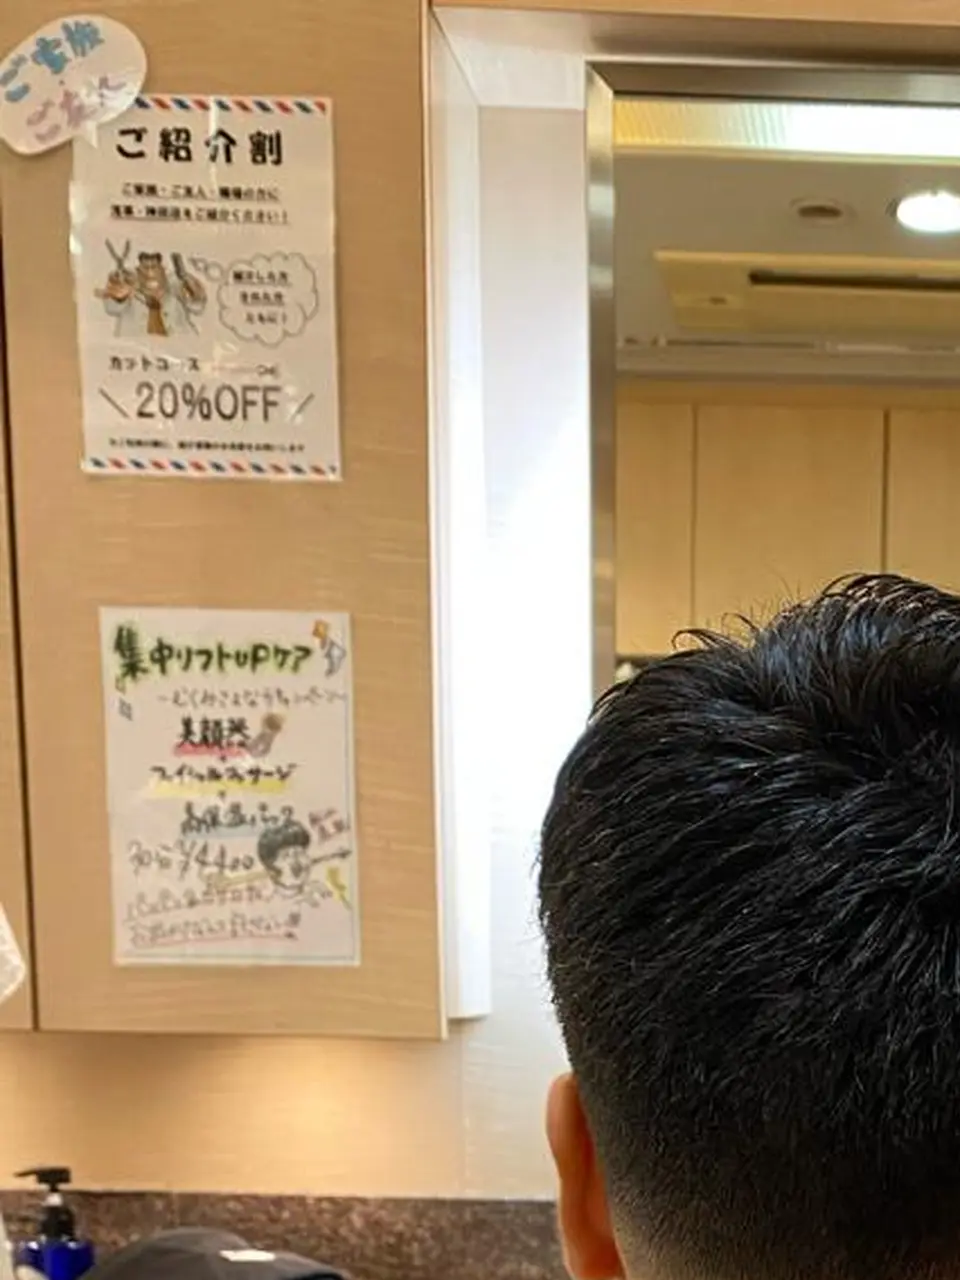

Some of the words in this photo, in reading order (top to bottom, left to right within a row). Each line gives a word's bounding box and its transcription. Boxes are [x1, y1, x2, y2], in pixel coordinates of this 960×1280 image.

[115, 126, 283, 167] ご紹介割
[135, 381, 282, 423] 20%OFF
